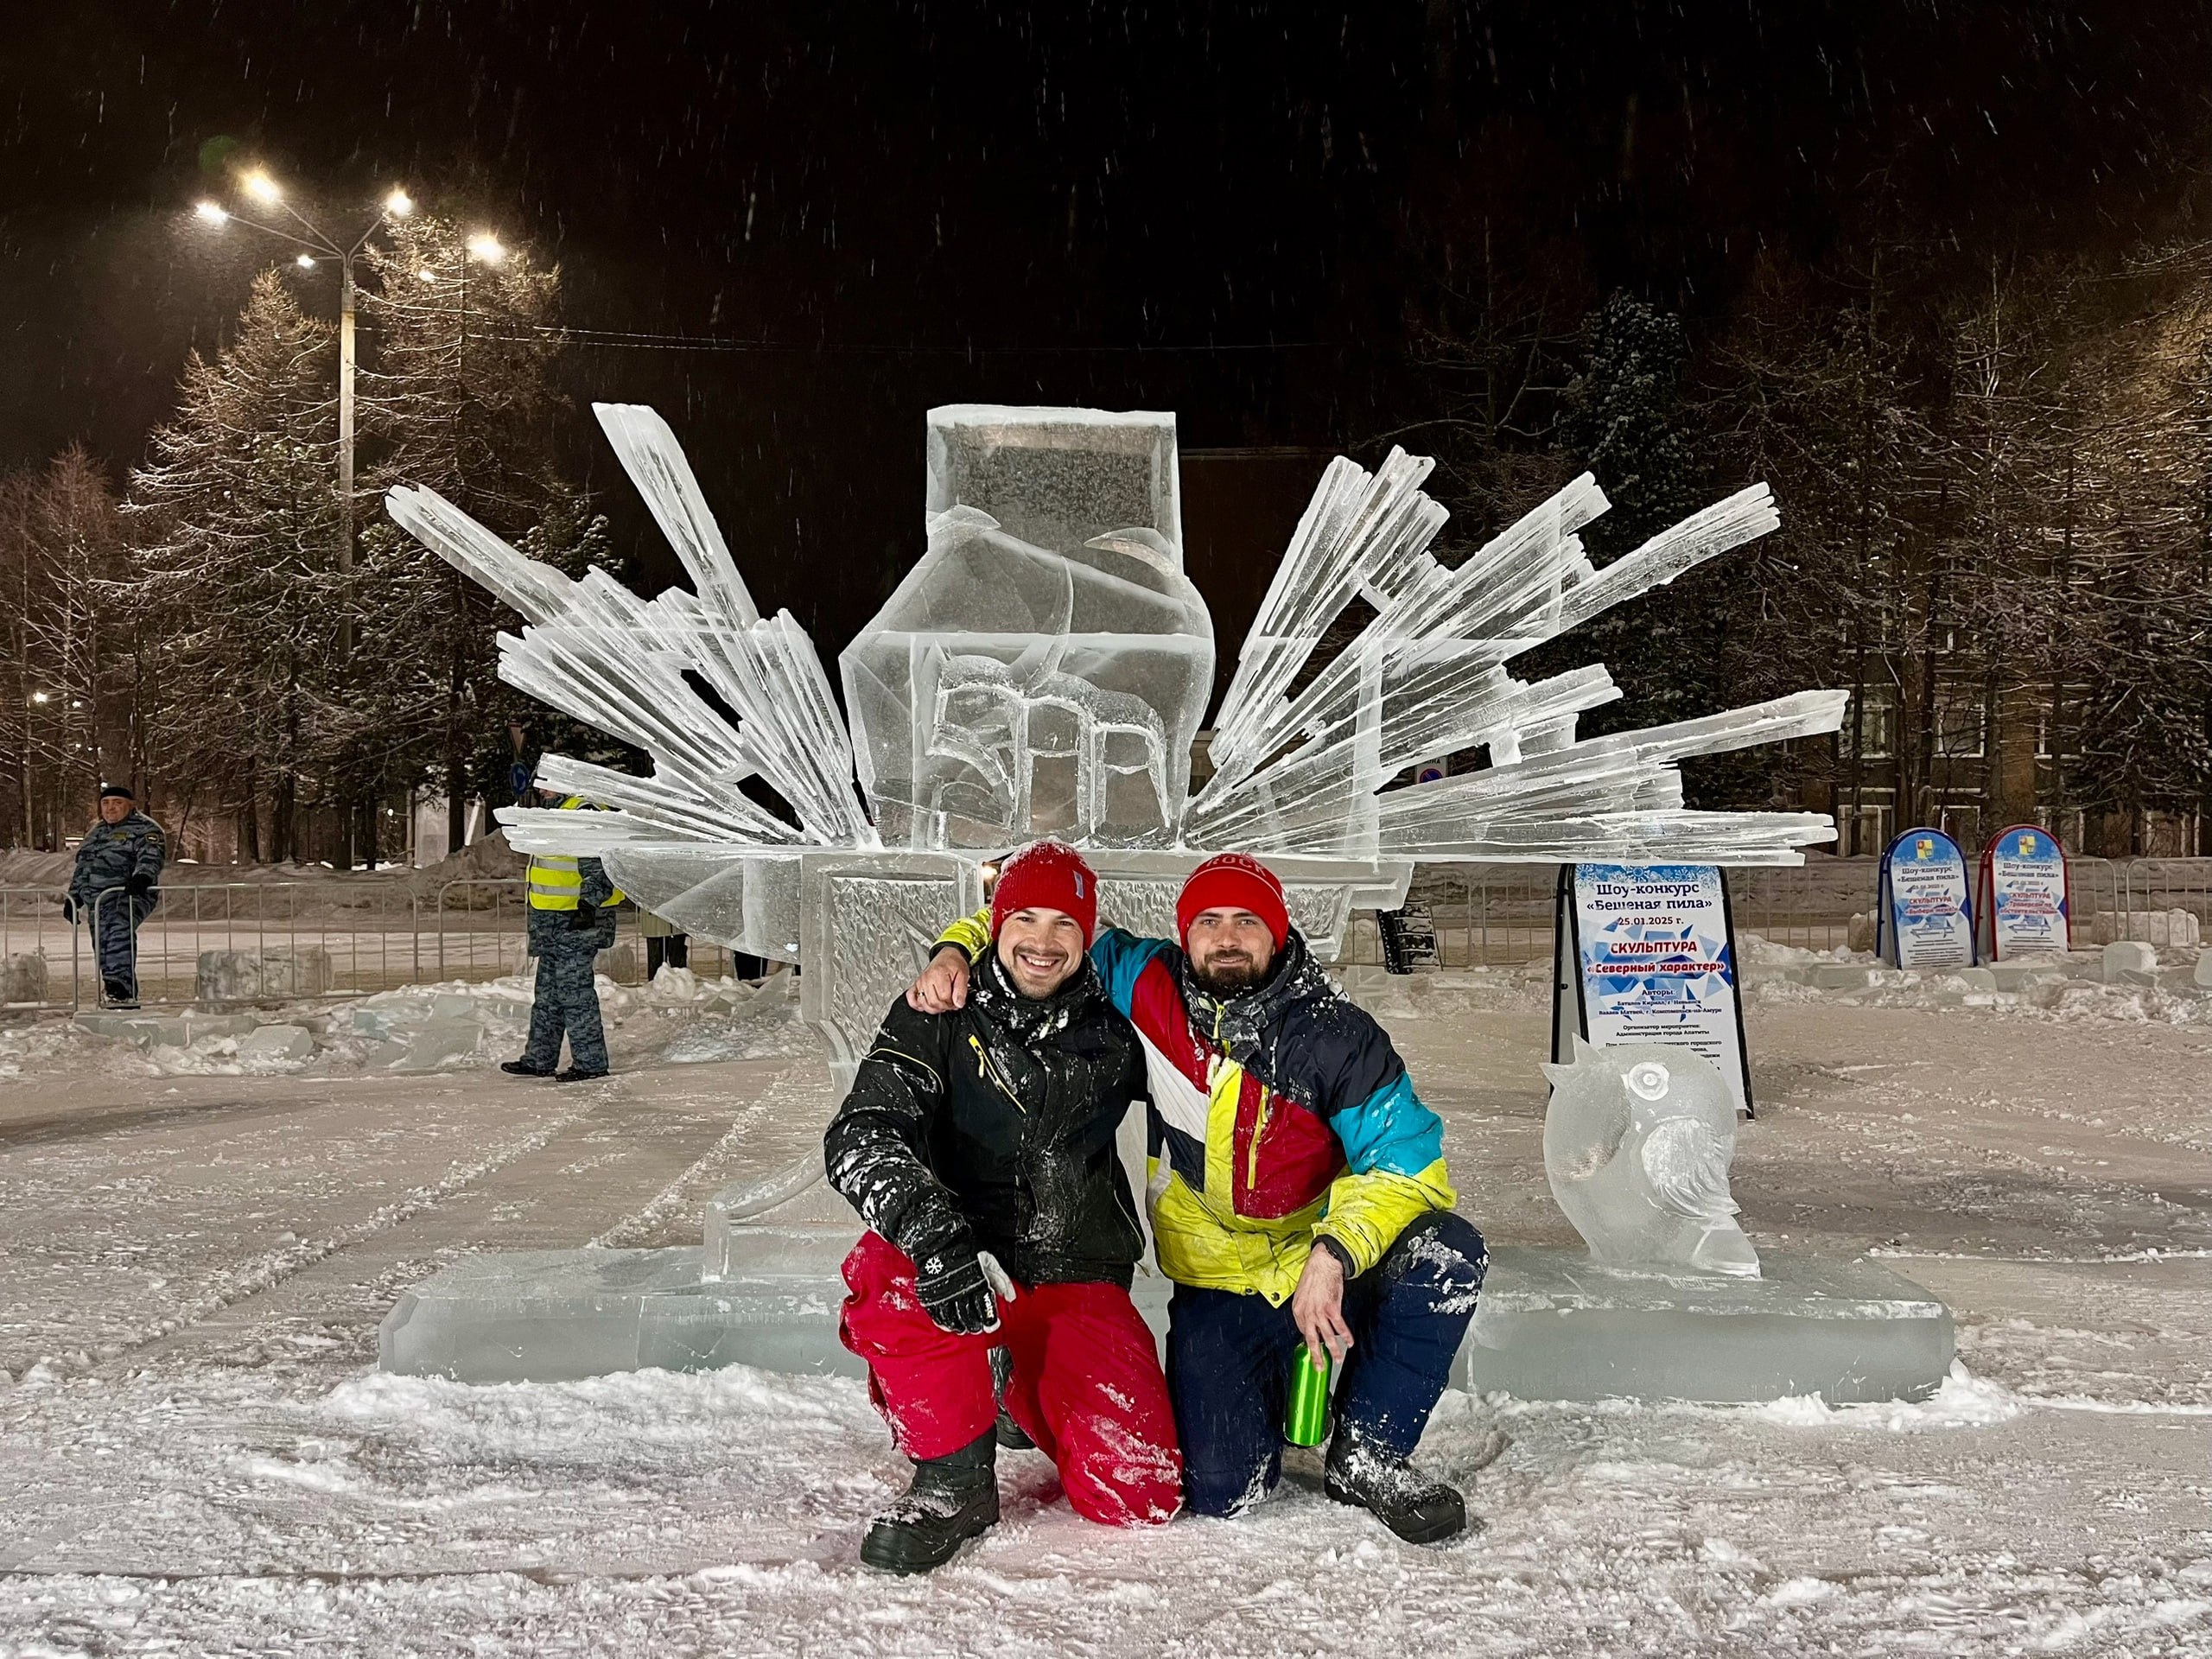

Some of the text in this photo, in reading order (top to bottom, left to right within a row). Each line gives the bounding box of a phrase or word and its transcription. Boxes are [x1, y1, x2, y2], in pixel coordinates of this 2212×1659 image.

[1206, 855, 1267, 878] ROCK
[1902, 866, 1953, 875] Шоу-конкурс
[1597, 884, 1700, 899] Шоу-конкурс
[1586, 899, 1713, 911] «Бешеная пила»
[1618, 917, 1684, 926] 25.01.2025 г.
[1611, 941, 1698, 955] СКУЛЬПТУРА
[1587, 962, 1725, 975] «Северный характер»
